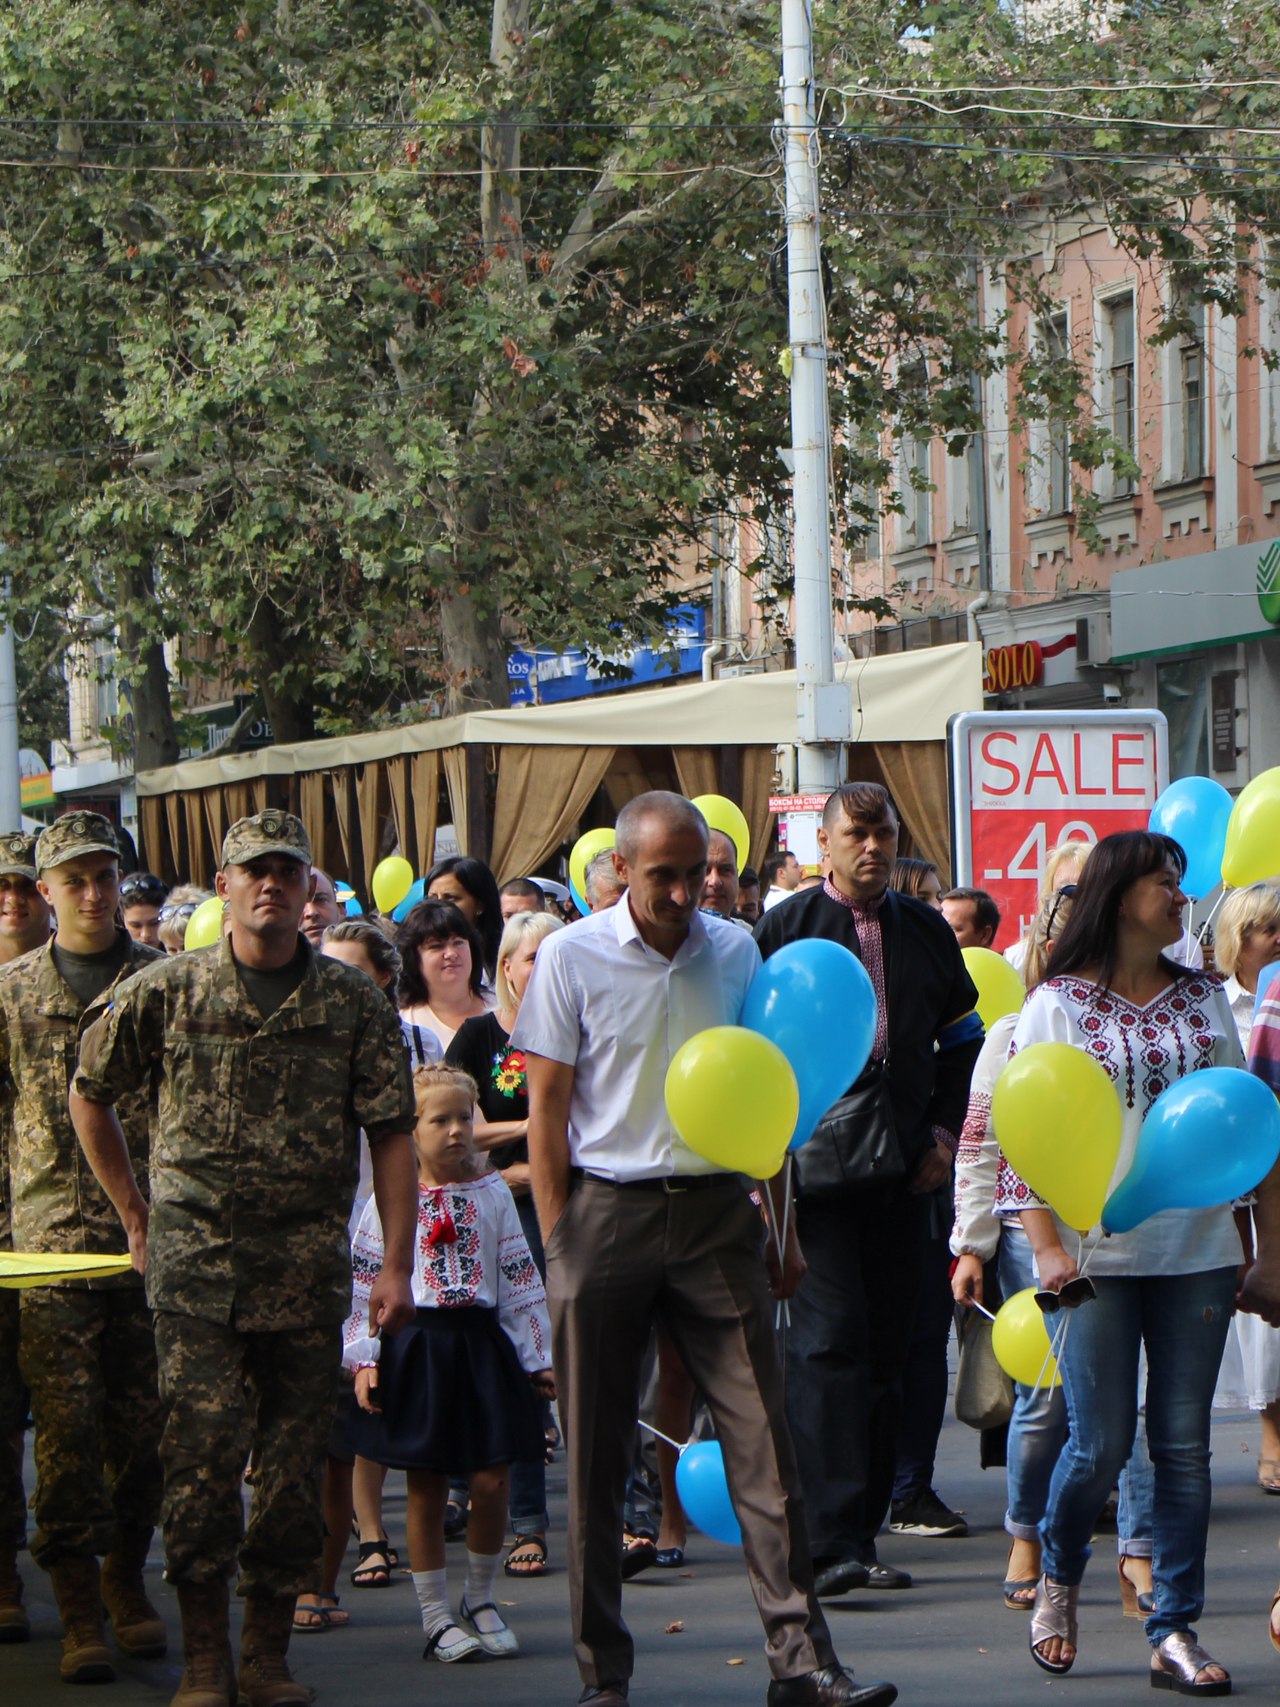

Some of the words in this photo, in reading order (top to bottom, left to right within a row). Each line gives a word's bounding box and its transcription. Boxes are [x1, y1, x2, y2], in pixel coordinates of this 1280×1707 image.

[987, 642, 1035, 693] SOLO
[981, 731, 1146, 796] SALE
[769, 798, 793, 806] БОКСЫ
